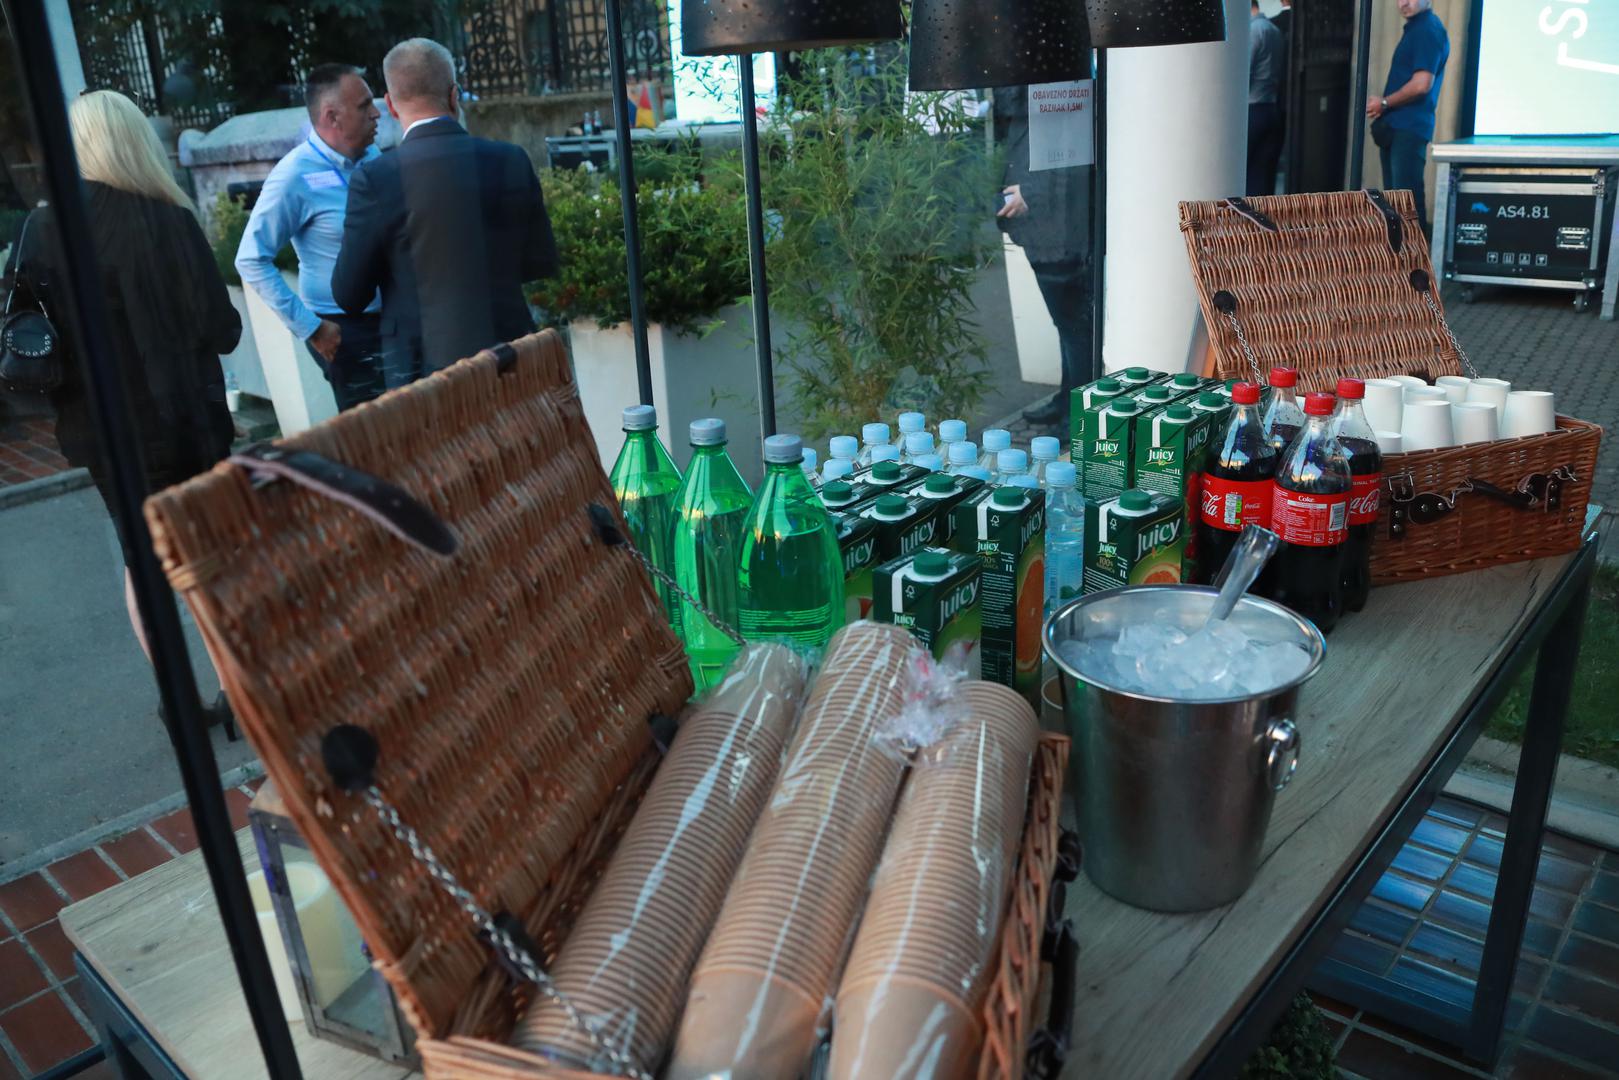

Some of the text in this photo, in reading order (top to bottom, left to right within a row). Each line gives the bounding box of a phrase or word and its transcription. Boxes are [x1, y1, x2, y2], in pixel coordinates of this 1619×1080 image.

[1032, 89, 1067, 100] OBAVEZNO
[1039, 103, 1065, 113] RAZMAK
[1496, 205, 1550, 219] AS4.81
[1094, 441, 1119, 454] Juicy
[1185, 423, 1210, 460] Juicy
[1147, 449, 1174, 463] Juicy
[901, 517, 937, 556] Juicy
[1019, 506, 1044, 554] Juicy
[1134, 517, 1181, 562] Juicy
[976, 541, 999, 553] Juicy
[1098, 542, 1117, 555] Juicy
[937, 576, 980, 632] Juicy
[894, 612, 916, 627] Juicy
